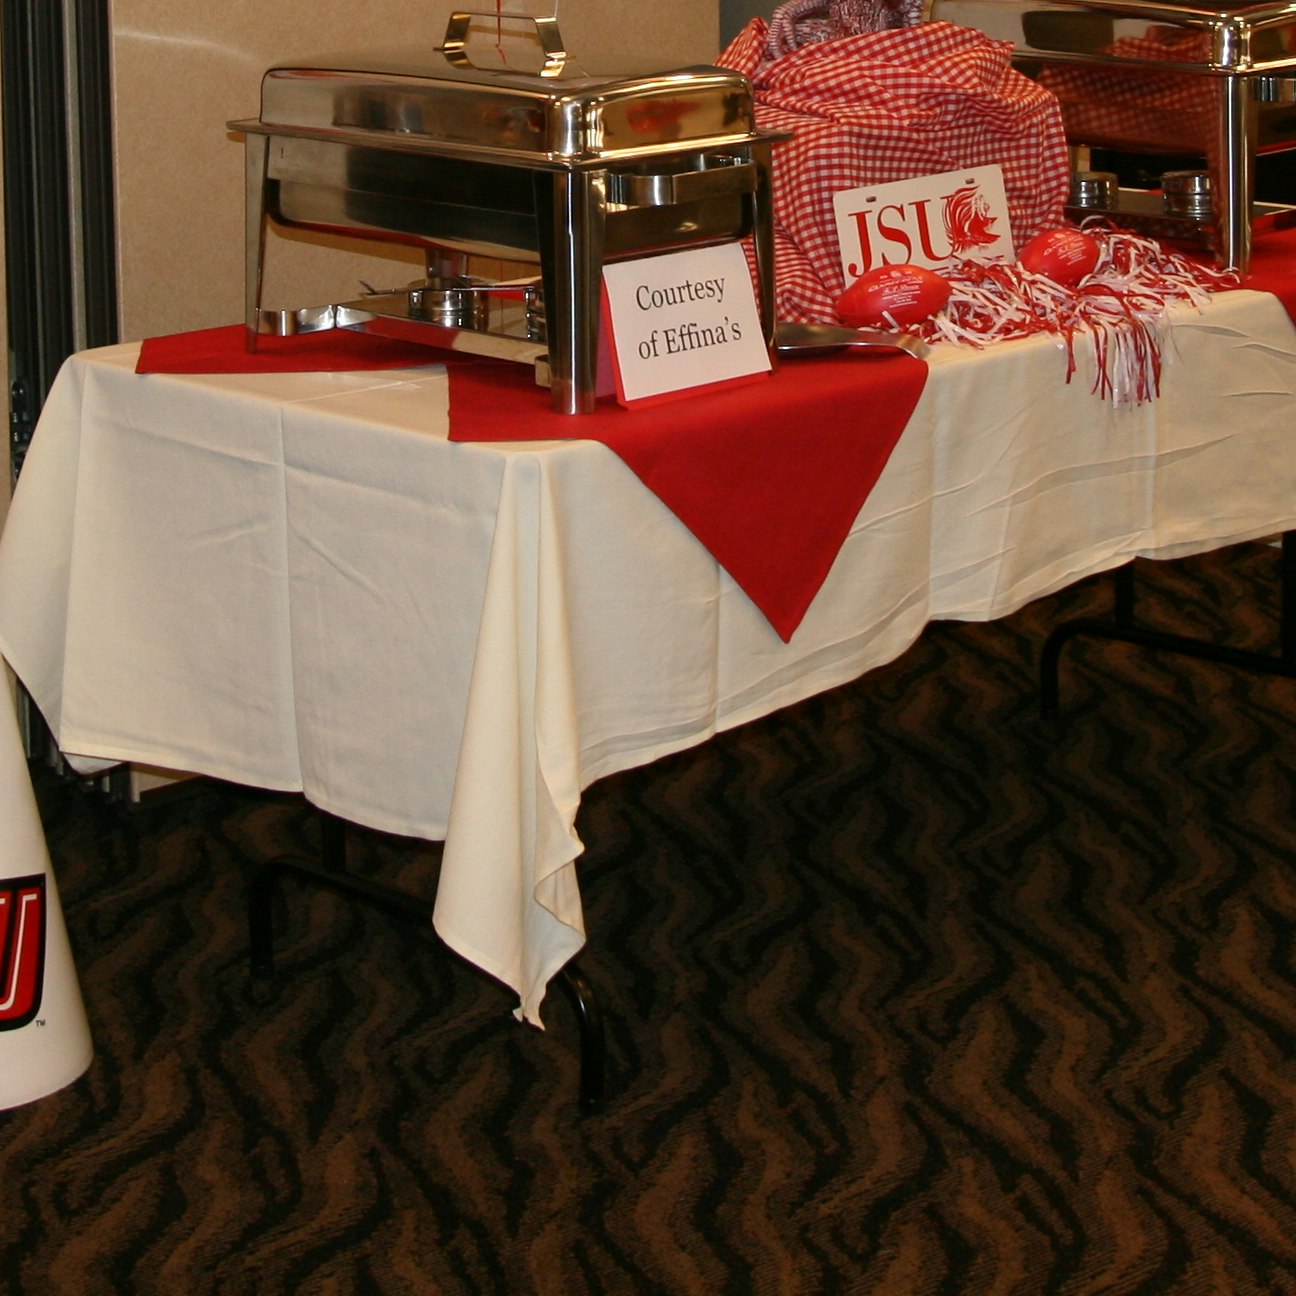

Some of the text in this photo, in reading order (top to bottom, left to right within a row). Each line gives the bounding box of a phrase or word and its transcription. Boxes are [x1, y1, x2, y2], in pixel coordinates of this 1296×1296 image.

[848, 194, 955, 278] JSU
[636, 277, 726, 311] Courtesy
[638, 316, 742, 360] of Effina's
[35, 1019, 46, 1028] TM
